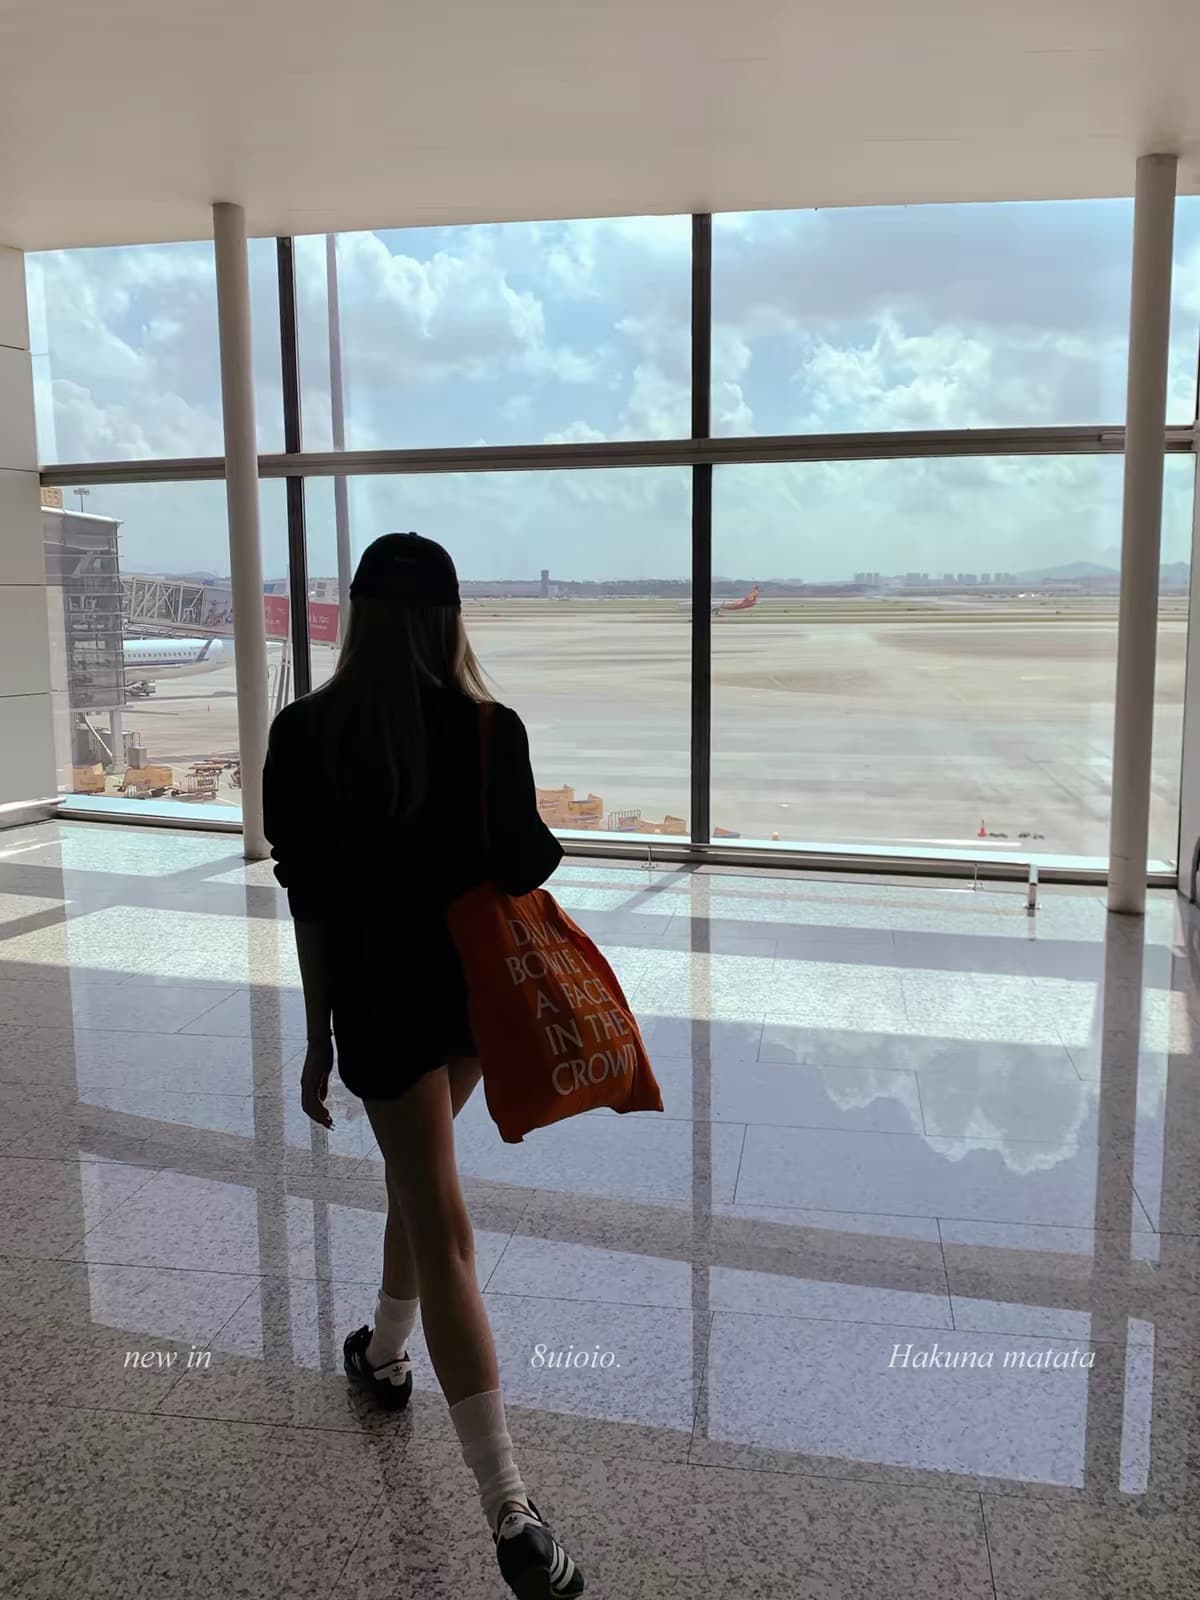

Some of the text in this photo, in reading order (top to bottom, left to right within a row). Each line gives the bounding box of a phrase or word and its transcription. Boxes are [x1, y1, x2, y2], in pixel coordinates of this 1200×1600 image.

[504, 949, 581, 985] BOWIE
[536, 978, 612, 1019] A FACE
[544, 1009, 629, 1056] IN THE
